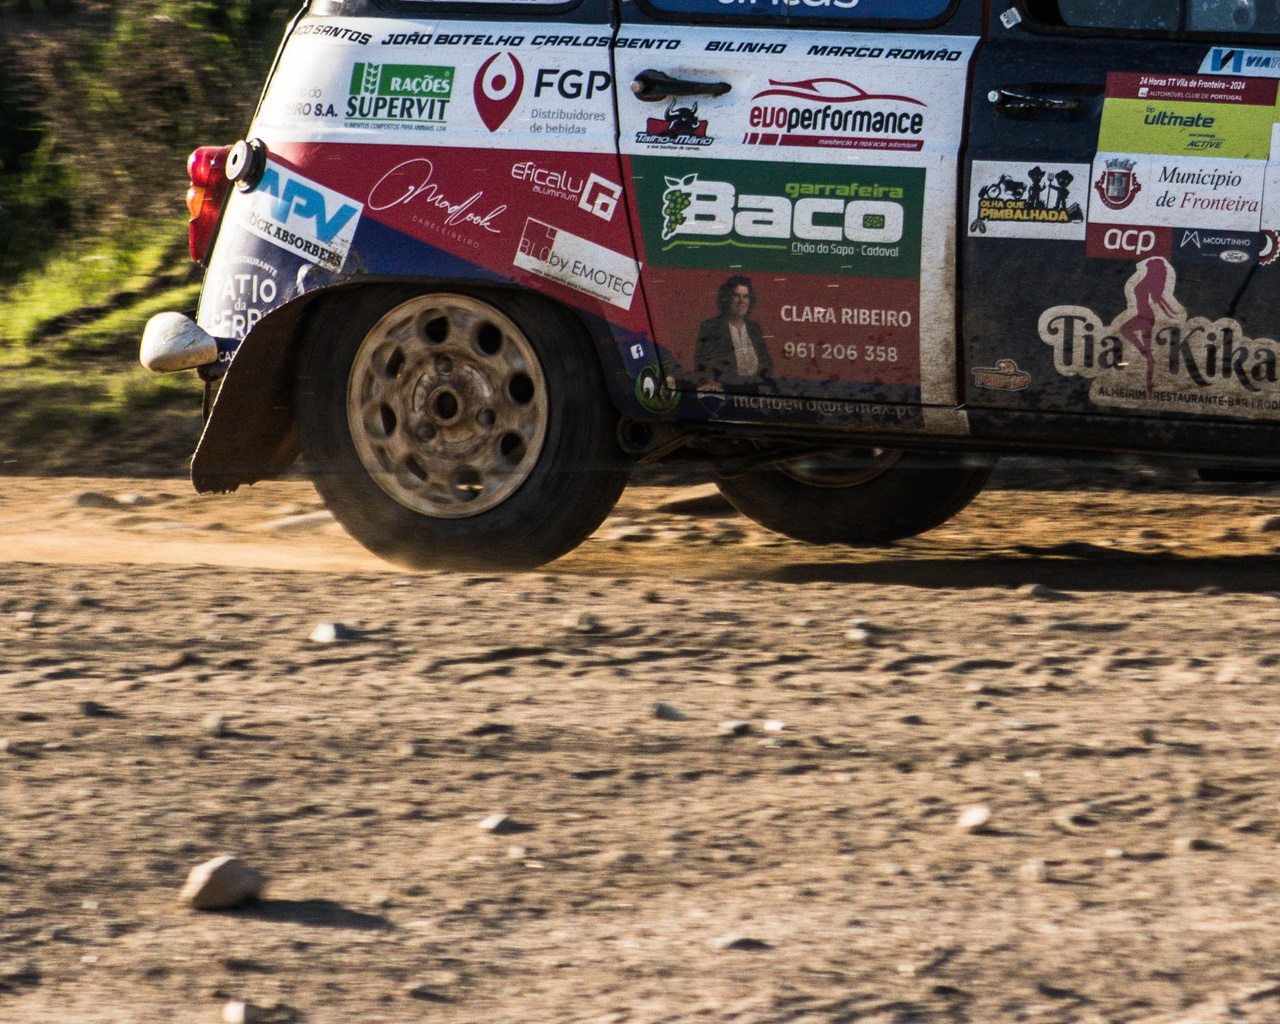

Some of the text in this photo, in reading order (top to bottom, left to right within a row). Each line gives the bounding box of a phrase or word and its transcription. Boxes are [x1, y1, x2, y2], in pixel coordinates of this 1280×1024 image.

[312, 25, 372, 46] SANTOS
[381, 31, 432, 45] JOÃO
[434, 34, 524, 46] BOTELHO
[531, 35, 613, 47] CARLOS
[615, 36, 681, 50] BENTO
[704, 41, 787, 54] BILINHO
[807, 44, 884, 58] MARCO
[390, 74, 450, 95] RAÇÕES
[534, 68, 612, 100] FGP
[1139, 76, 1246, 90] 24 Horas TT Vila de Fronteira 2024
[314, 103, 338, 117] S.A.
[346, 96, 450, 121] SUPERVIT
[531, 108, 606, 122] Distribuidores
[1144, 111, 1215, 128] ultimate
[530, 123, 587, 135] de bebidas
[1187, 140, 1224, 149] ACTIVE
[1158, 166, 1242, 191] Município
[785, 182, 904, 198] garrafeira
[662, 173, 904, 243] Baco
[980, 200, 1026, 210] OLHA QUE
[1156, 192, 1260, 214] de Fronteira
[980, 208, 1069, 222] PIMBALHADA
[791, 242, 899, 257] Chão Cadaval
[1103, 228, 1155, 255] acp
[1202, 237, 1251, 247] MCOUTINHO
[548, 251, 569, 272] by
[571, 260, 634, 296] EMOTEC
[234, 297, 247, 311] da
[780, 305, 912, 328] CLARA RIBEIRO
[1047, 315, 1125, 371] Tia
[784, 342, 899, 362] 961 206 358
[1098, 386, 1146, 400] ALMEIRIM
